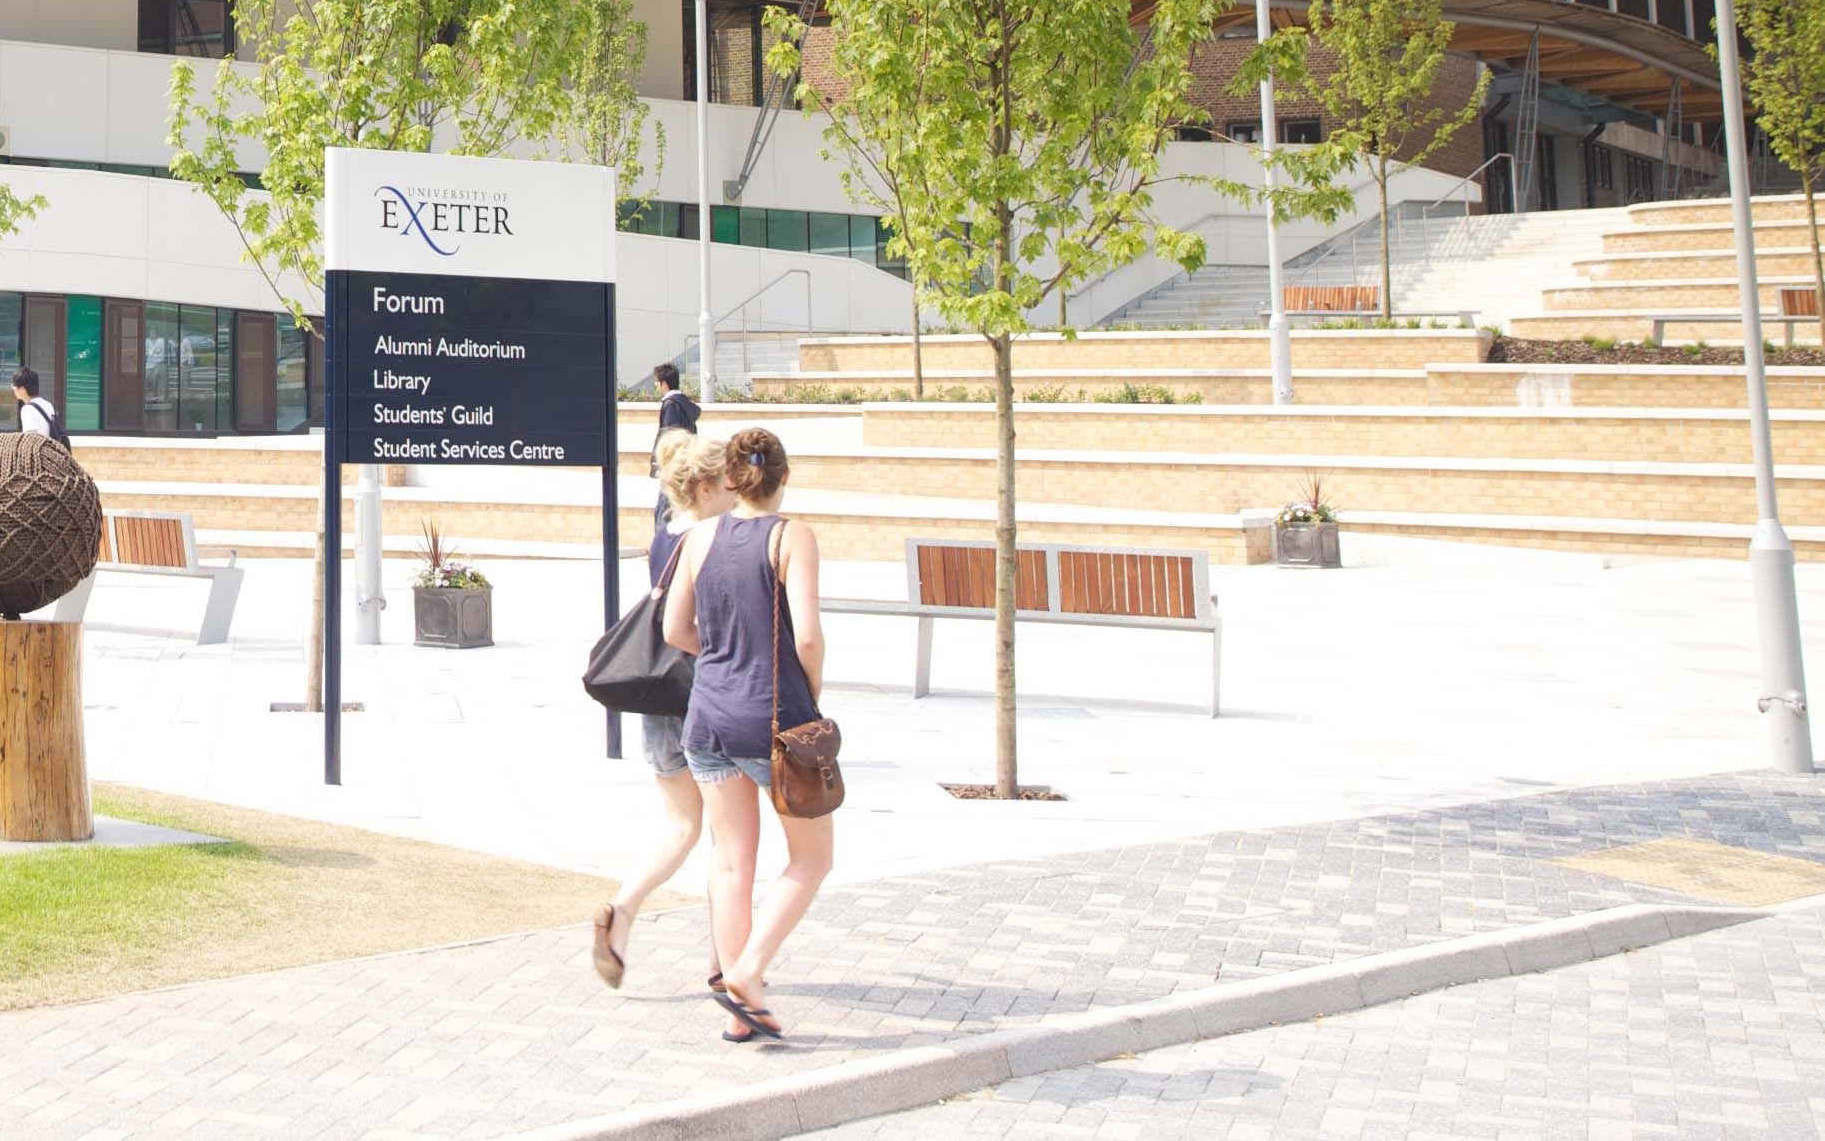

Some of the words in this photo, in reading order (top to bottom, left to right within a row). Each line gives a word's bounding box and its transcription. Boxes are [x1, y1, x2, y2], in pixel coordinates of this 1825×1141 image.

[407, 187, 488, 201] UNIVERSITY
[493, 192, 509, 202] OF
[375, 186, 514, 256] EXETER
[373, 287, 444, 314] Forum
[375, 335, 432, 356] Alumni
[435, 337, 525, 359] Auditorium
[374, 369, 431, 395] Library
[374, 403, 446, 424] Students'
[451, 405, 493, 425] Guild
[374, 437, 436, 458] Student
[440, 439, 505, 458] Services
[509, 440, 565, 459] Centre
